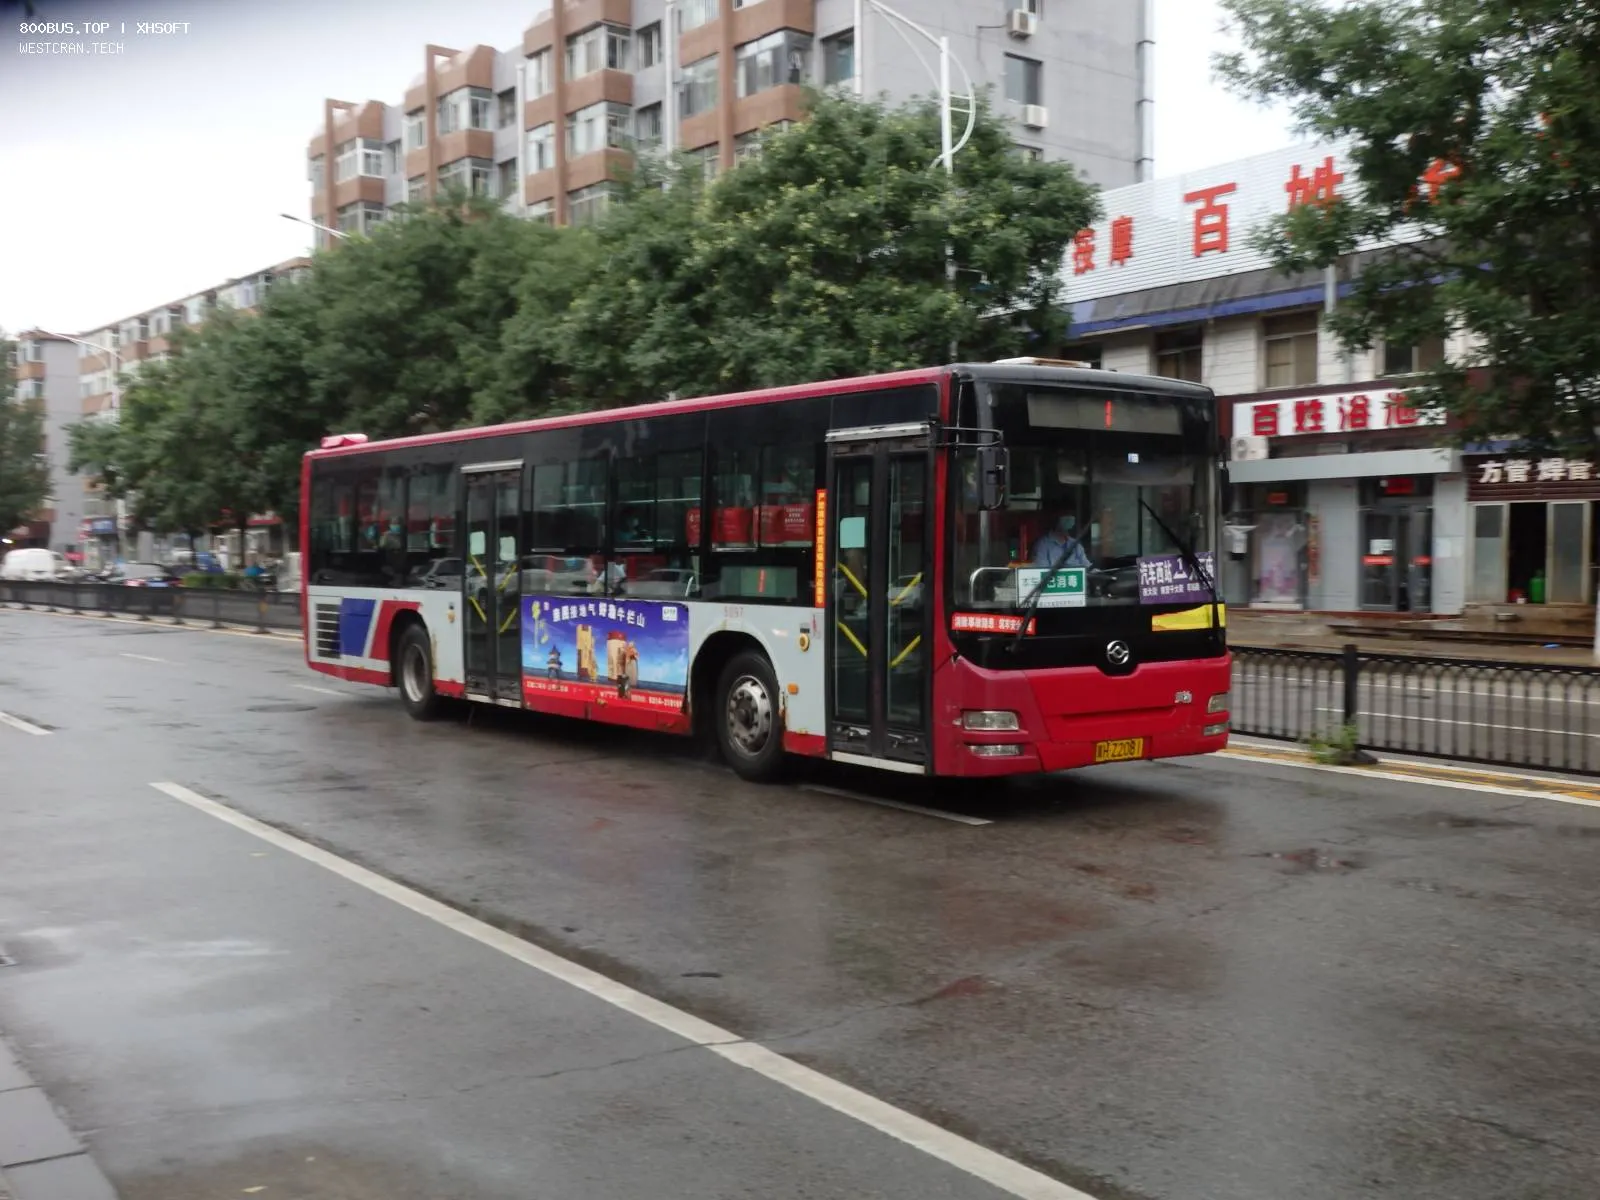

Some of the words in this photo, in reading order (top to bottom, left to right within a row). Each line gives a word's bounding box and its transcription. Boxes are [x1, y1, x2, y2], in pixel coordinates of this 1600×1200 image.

[1104, 400, 1113, 430] 1
[1250, 391, 1419, 438] 百姓浴池
